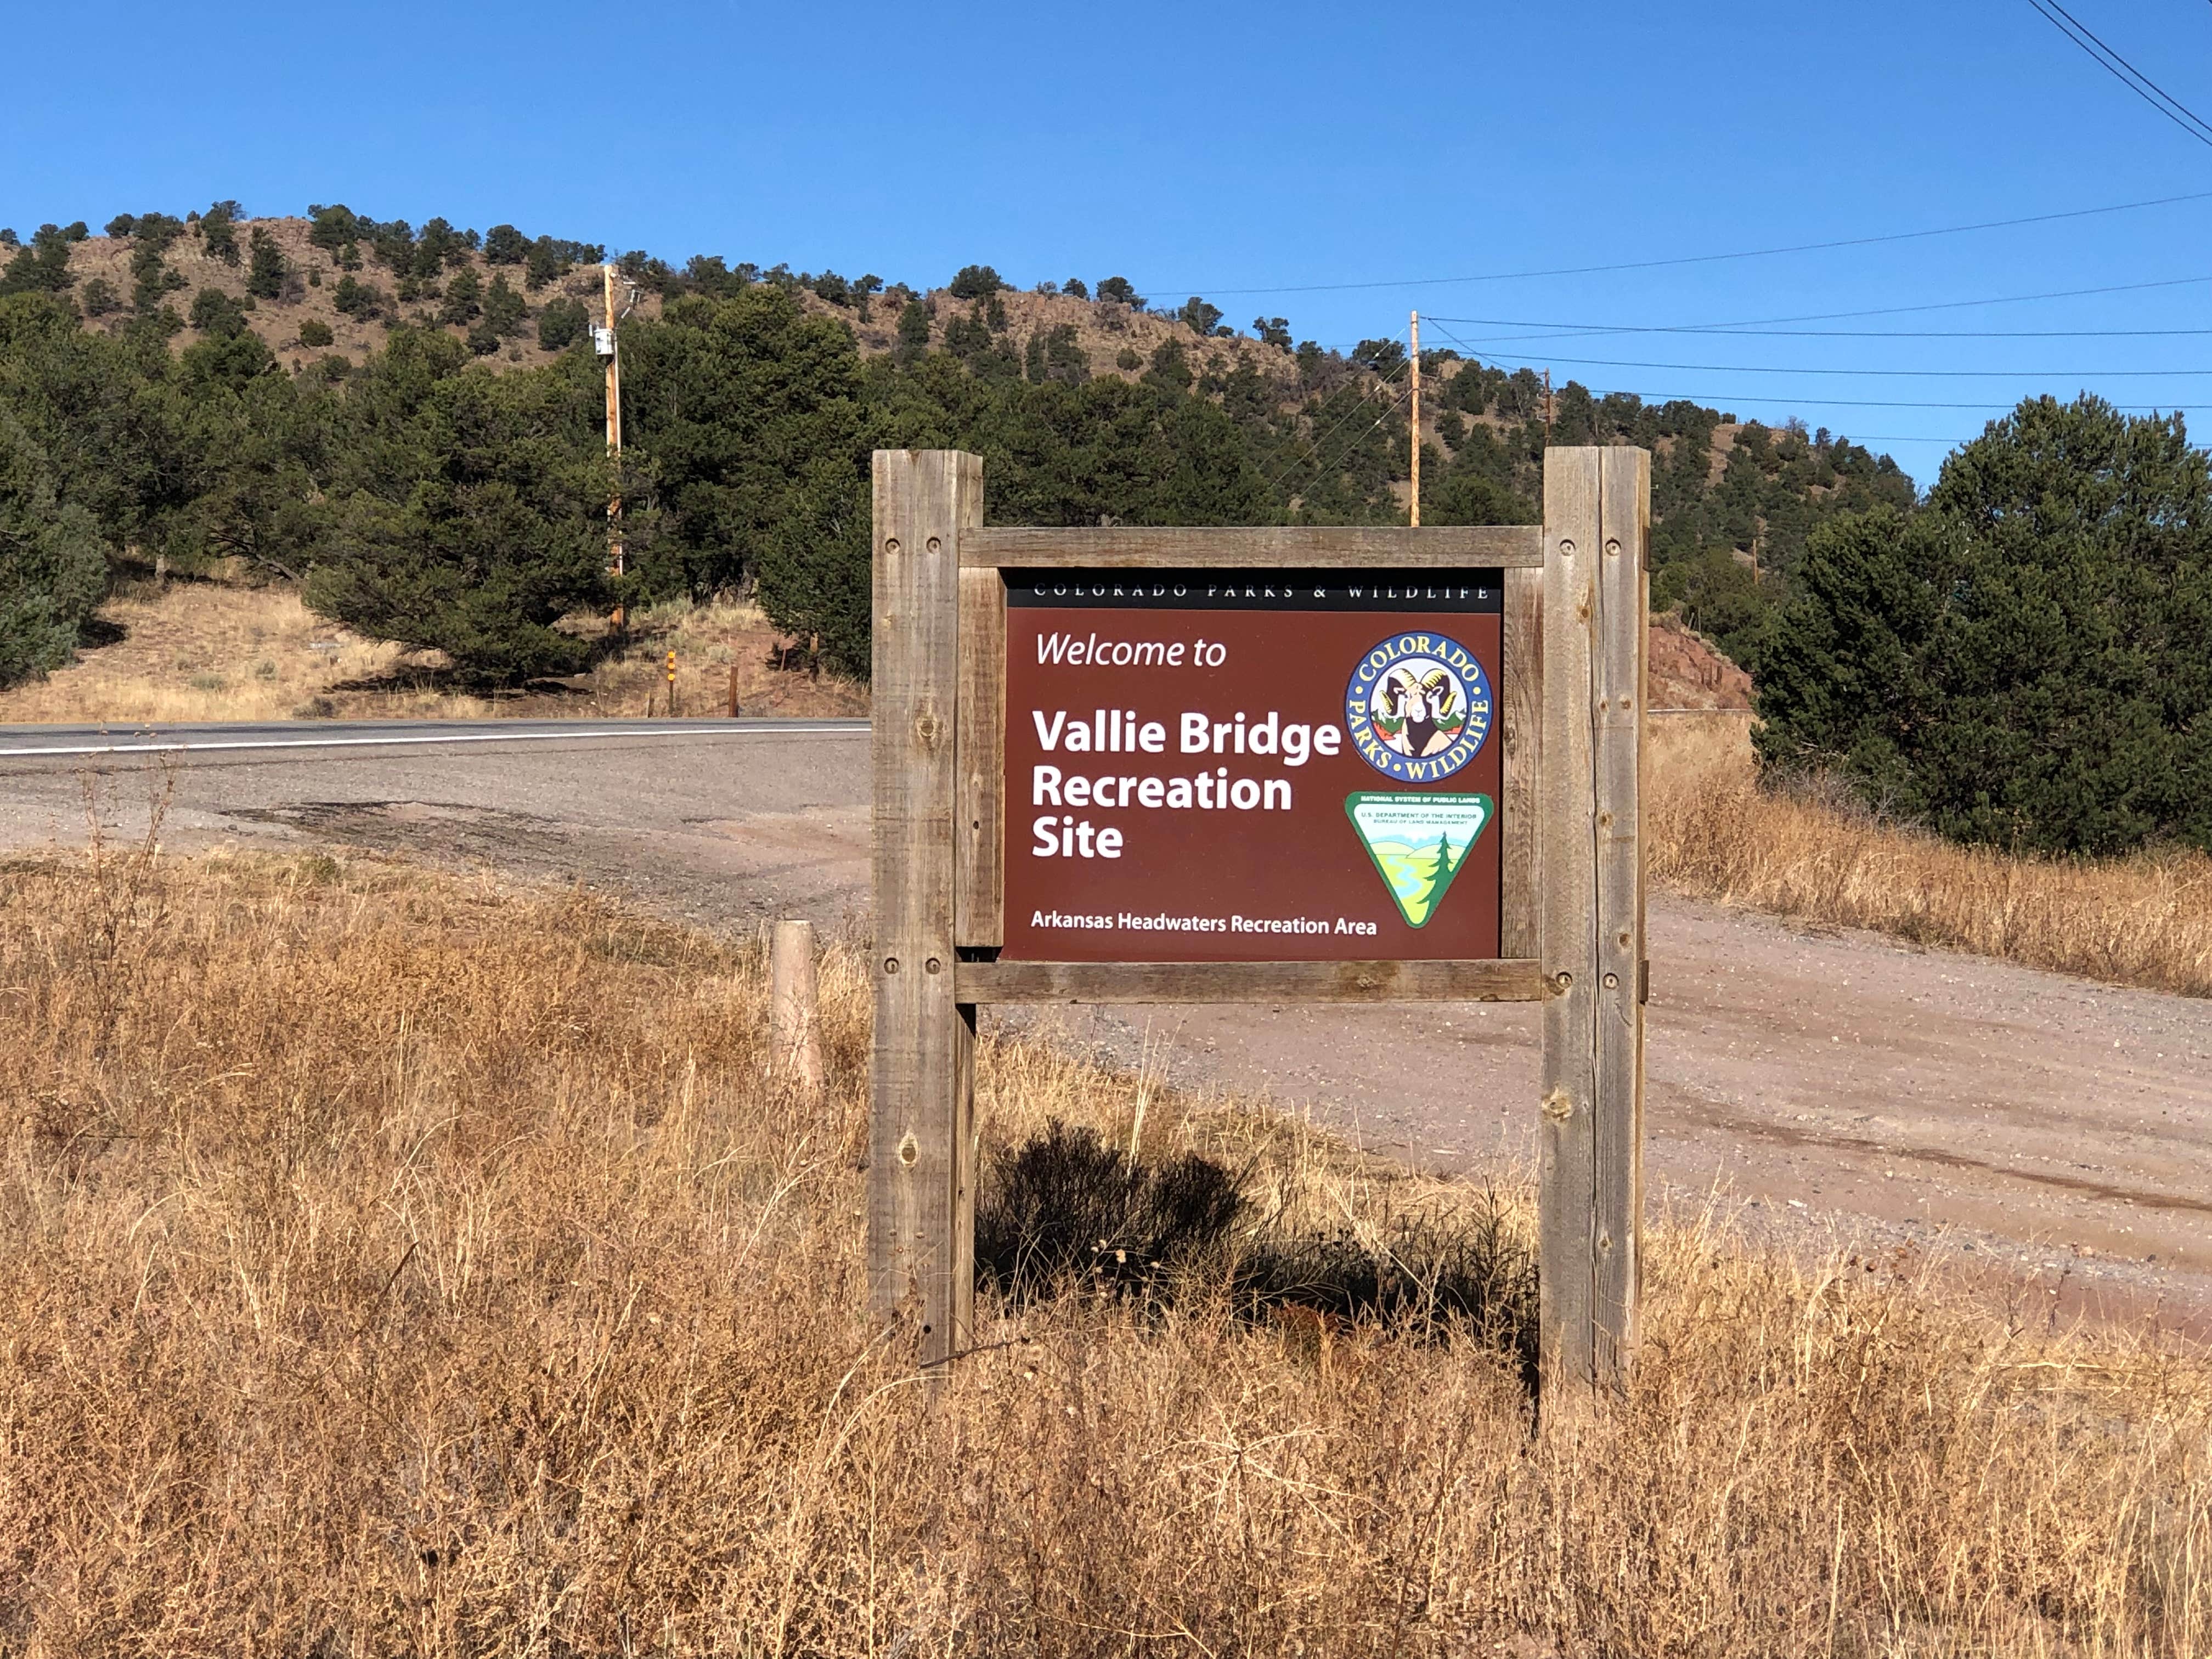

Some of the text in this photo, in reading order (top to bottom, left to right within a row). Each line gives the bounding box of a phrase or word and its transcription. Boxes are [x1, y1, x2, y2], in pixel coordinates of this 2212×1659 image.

[1034, 583, 1489, 600] COLORADO PARKS & WILDLIFE
[1037, 632, 1227, 667] Welcome to
[1358, 636, 1480, 682] COLORADO
[1032, 709, 1342, 766] Vallie Bridge
[1349, 699, 1489, 780] PARKS WILDLIFE
[1032, 765, 1292, 810] Recreation
[1032, 816, 1124, 859] Site
[1031, 911, 1378, 936] Arkansas Headwaters Recreation Area
